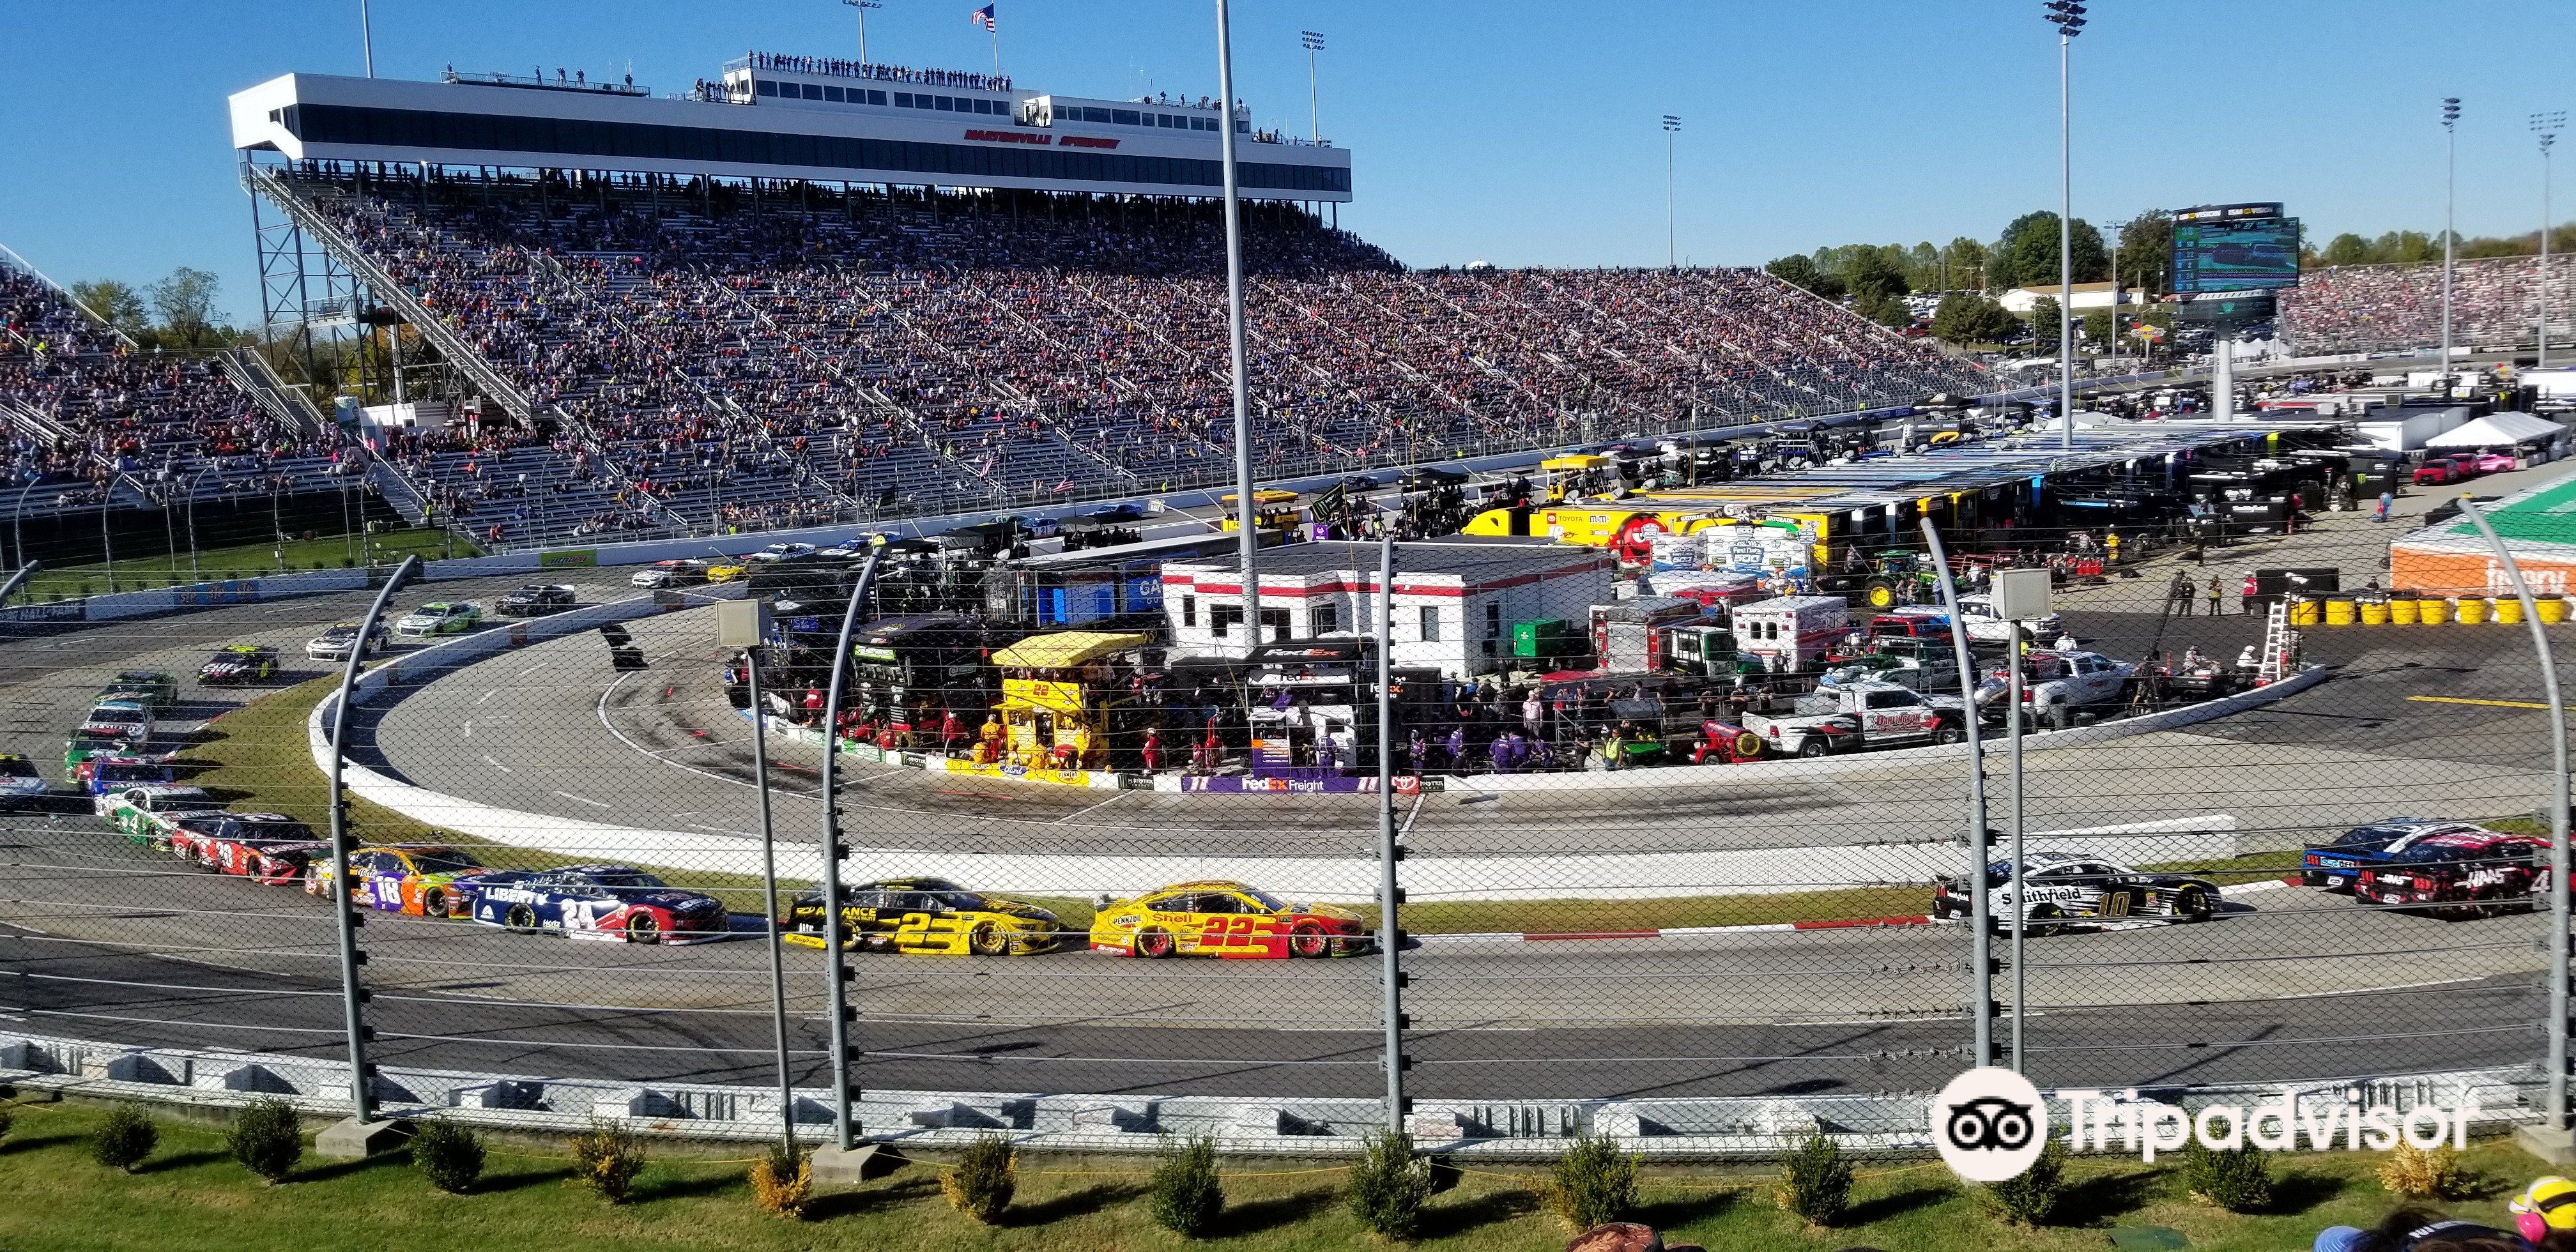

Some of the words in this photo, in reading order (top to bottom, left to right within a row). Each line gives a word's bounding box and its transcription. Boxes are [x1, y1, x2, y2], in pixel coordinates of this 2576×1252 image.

[964, 130, 1052, 144] MARTINSVILLE
[1280, 669, 1317, 682] FedEx
[1033, 684, 1049, 696] 22
[1004, 766, 1022, 775] Ford
[1242, 777, 1287, 791] FedEx
[1289, 779, 1324, 792] Freight
[2467, 869, 2505, 889] HAAS
[376, 875, 401, 904] 18
[2002, 889, 2082, 904] Sithfield
[2097, 892, 2130, 919] 10
[1113, 915, 1142, 925] PENNZOIL
[1153, 913, 1192, 922] Shell
[1200, 917, 1254, 946] 22
